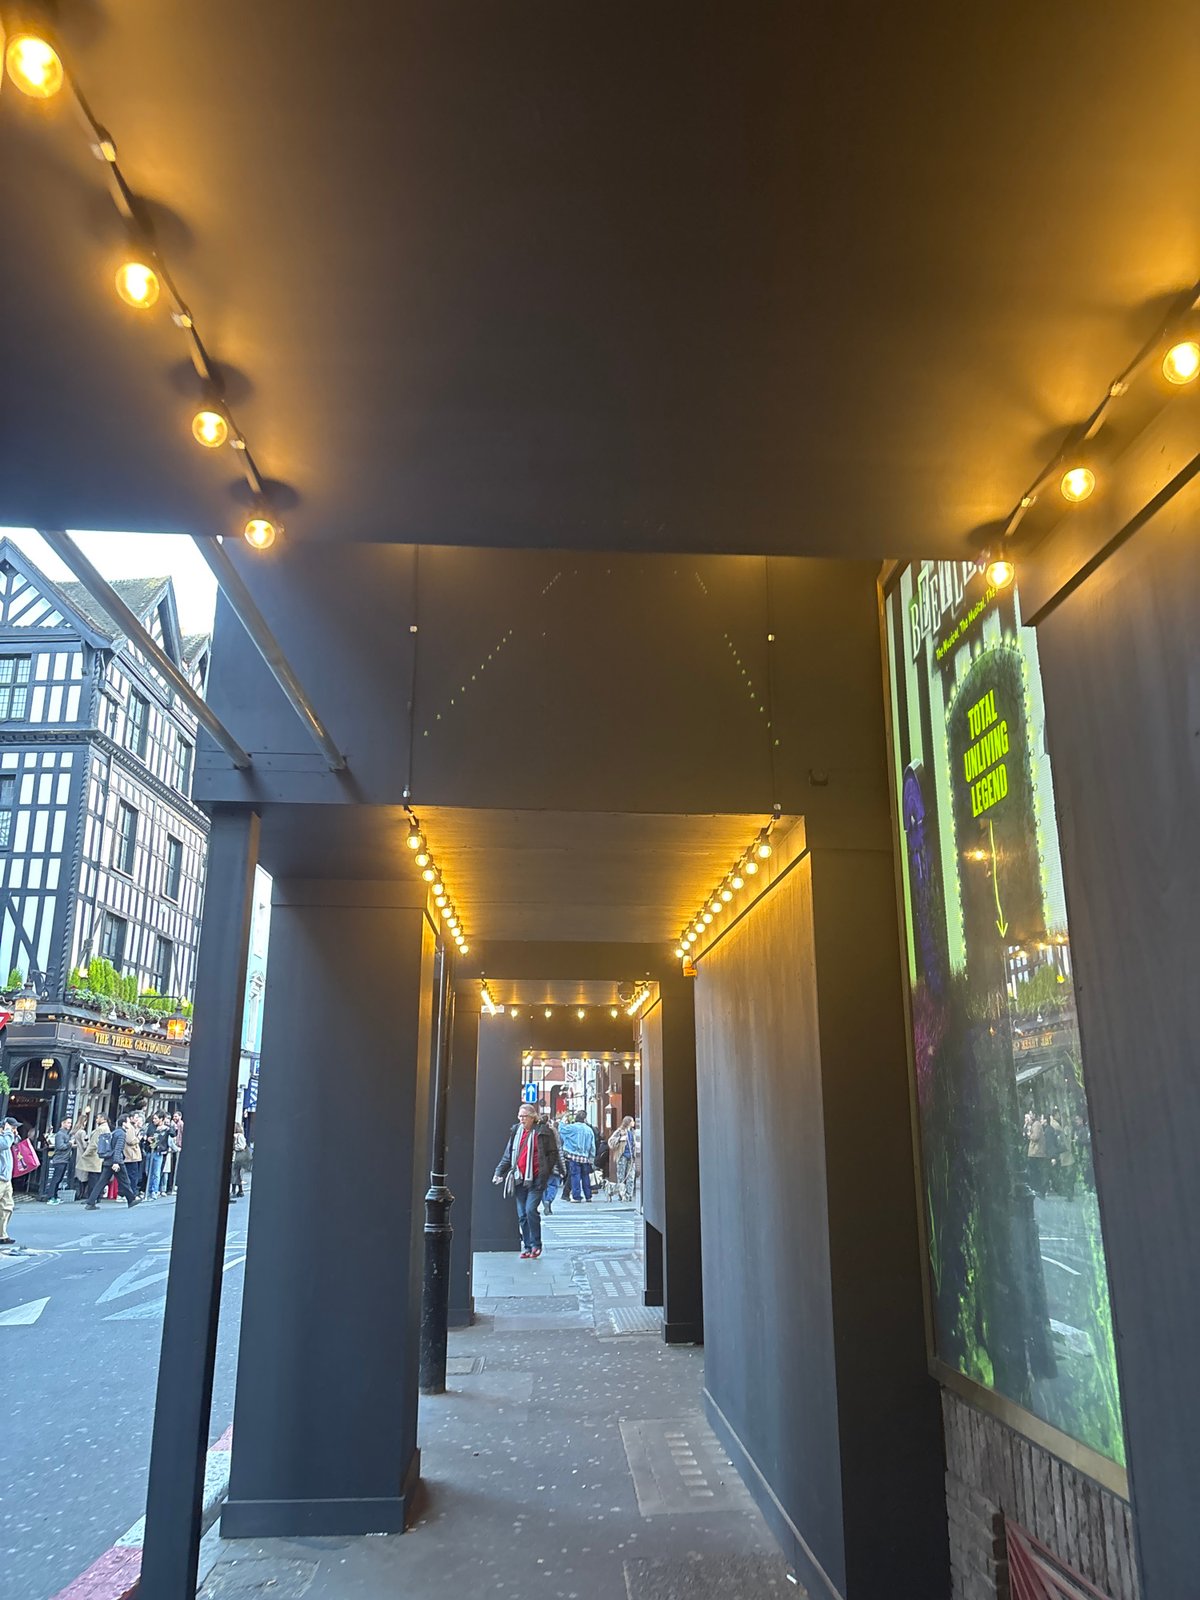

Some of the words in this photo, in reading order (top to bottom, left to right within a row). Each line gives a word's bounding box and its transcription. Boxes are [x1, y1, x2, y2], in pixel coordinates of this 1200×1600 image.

[967, 689, 998, 740] TOTAL
[964, 720, 1009, 783] UNLIVING
[971, 763, 1008, 818] LEGEND
[95, 1032, 109, 1045] THE
[111, 1035, 133, 1049] THREE
